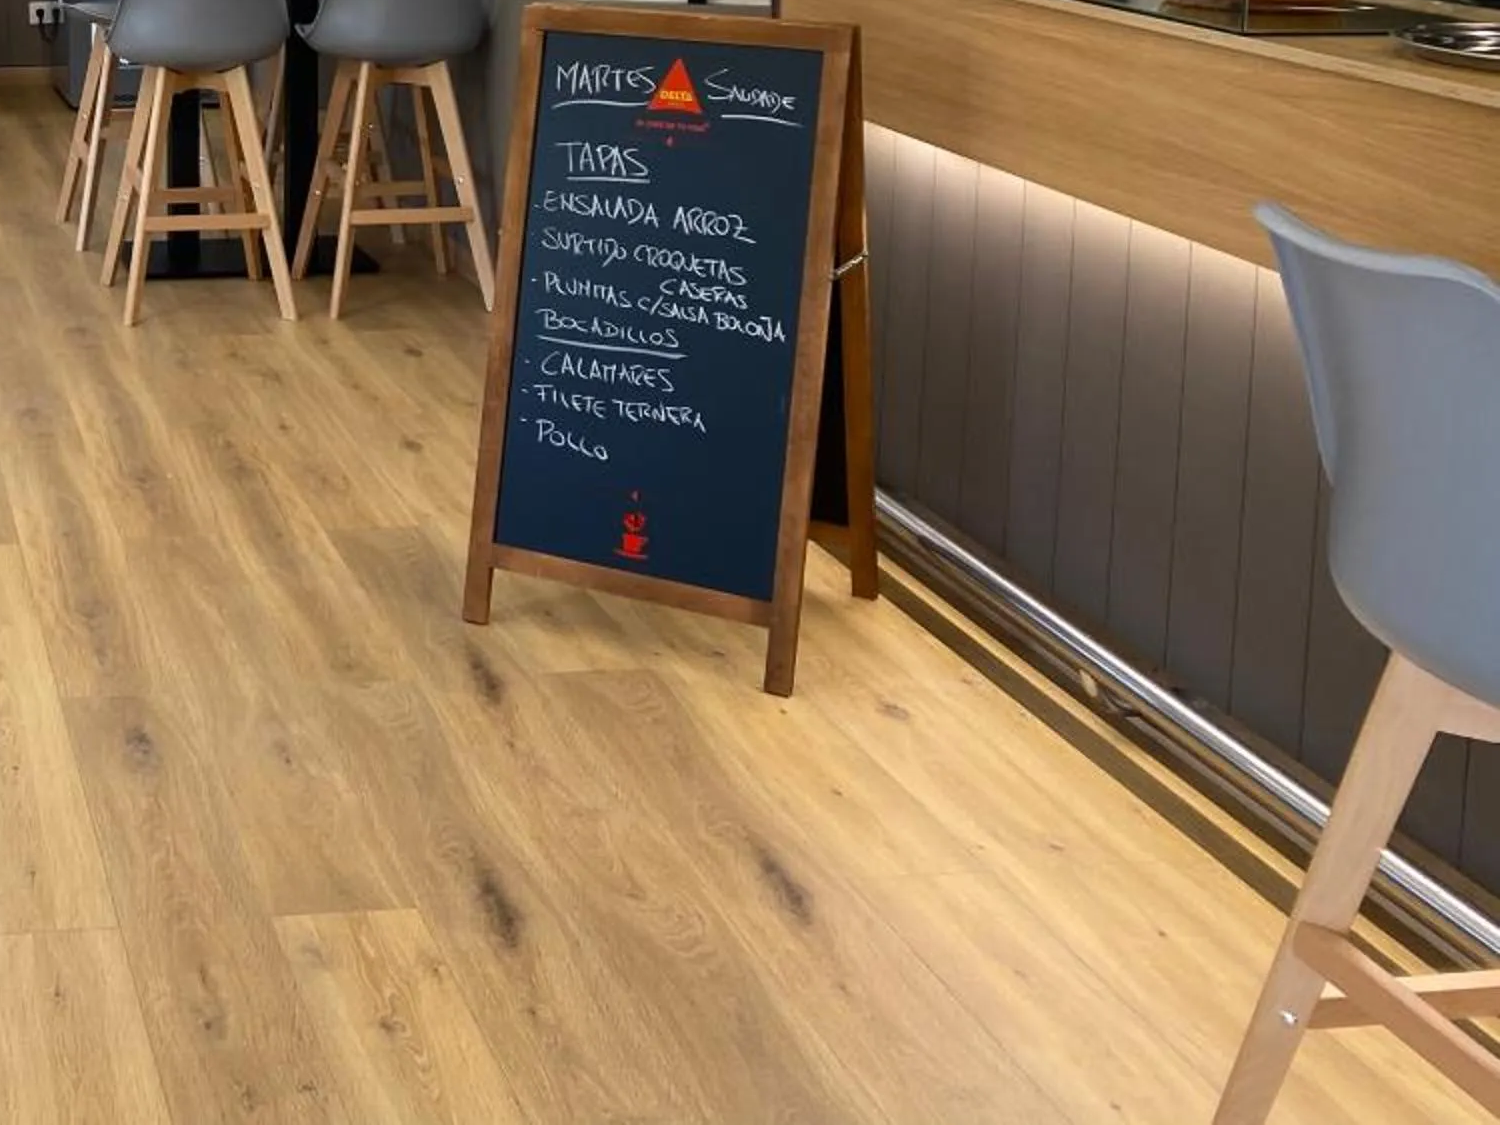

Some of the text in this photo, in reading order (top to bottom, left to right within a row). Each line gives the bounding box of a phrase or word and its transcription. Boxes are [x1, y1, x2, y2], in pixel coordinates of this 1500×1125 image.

[555, 61, 657, 95] MARTES
[660, 90, 693, 102] DELTA
[554, 141, 649, 177] TAPAS
[672, 206, 757, 244] ARROZ
[541, 227, 747, 286] SURTIDO CROQUETAS
[659, 278, 748, 310] CASERAS
[534, 307, 679, 348] BOCADILLOS
[541, 350, 675, 392] CALAMARES
[533, 383, 707, 433] FILETE TERNERA
[535, 418, 609, 460] POLLO
